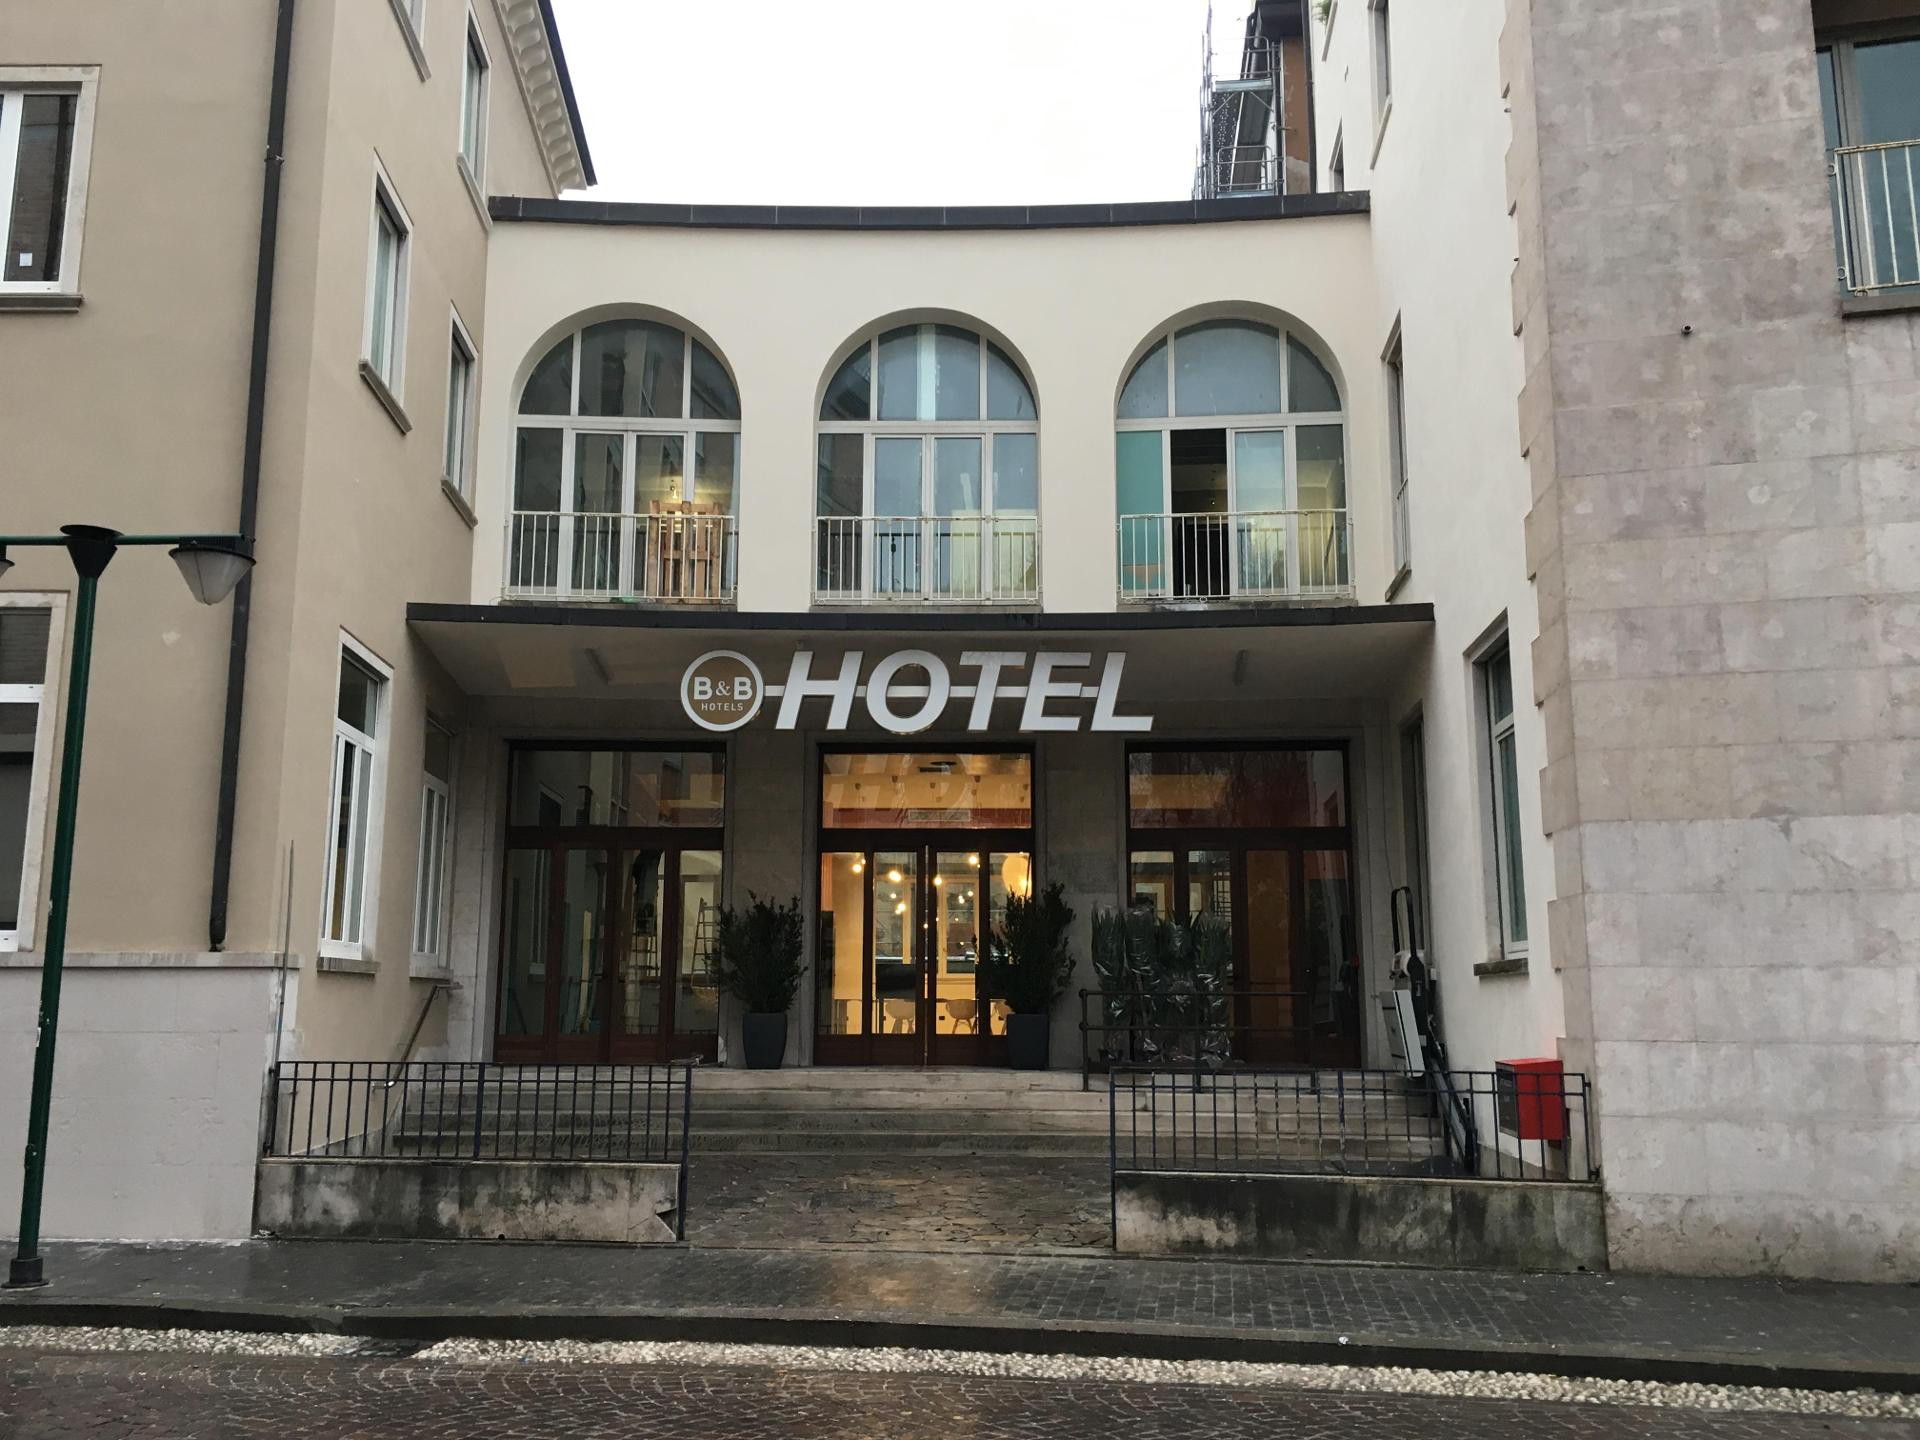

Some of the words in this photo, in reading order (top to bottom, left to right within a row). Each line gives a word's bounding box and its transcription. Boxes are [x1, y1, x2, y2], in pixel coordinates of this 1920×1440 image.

[694, 676, 753, 700] B&B
[775, 650, 1154, 732] HOTEL
[701, 703, 744, 711] HOTELS
